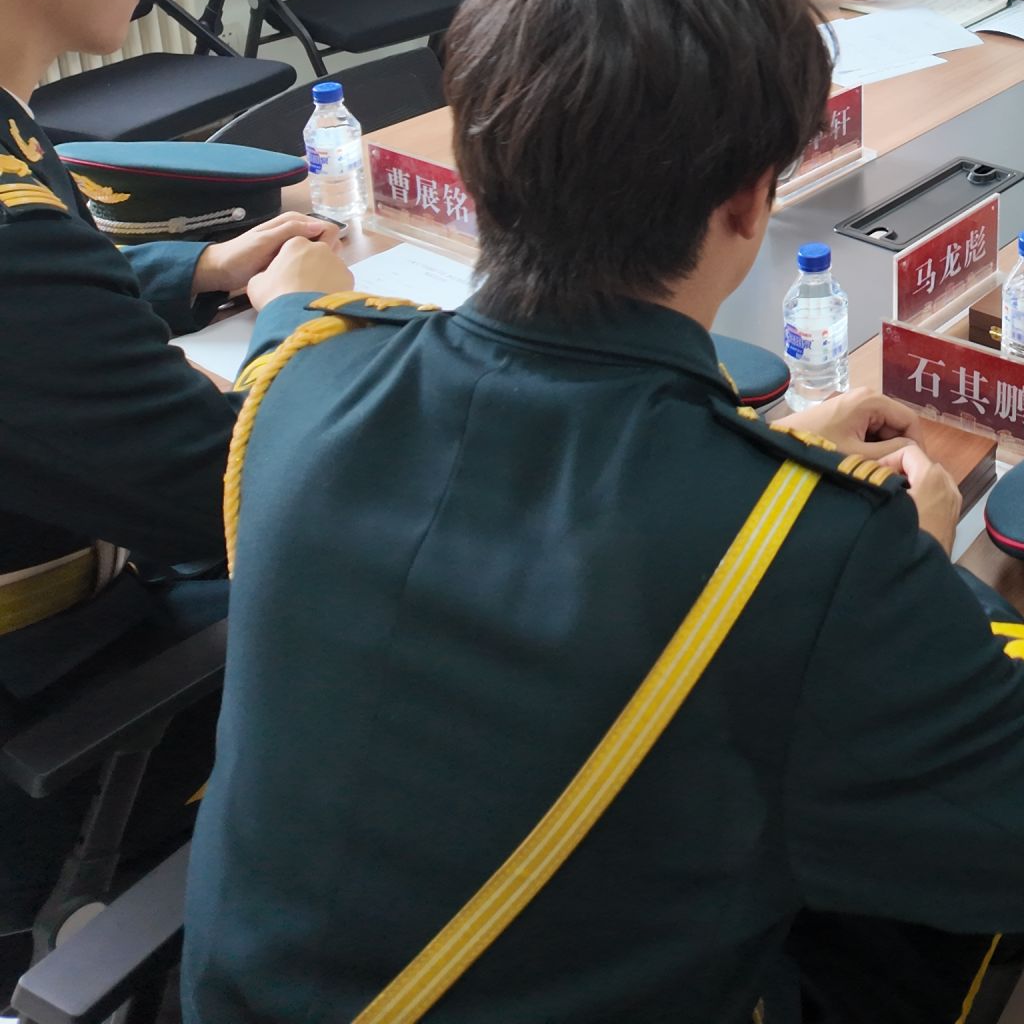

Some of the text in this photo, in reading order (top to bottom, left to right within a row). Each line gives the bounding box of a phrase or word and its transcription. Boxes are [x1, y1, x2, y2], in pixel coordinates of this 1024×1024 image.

[385, 167, 469, 223] 曹展铭
[912, 226, 987, 295] 马龙彪
